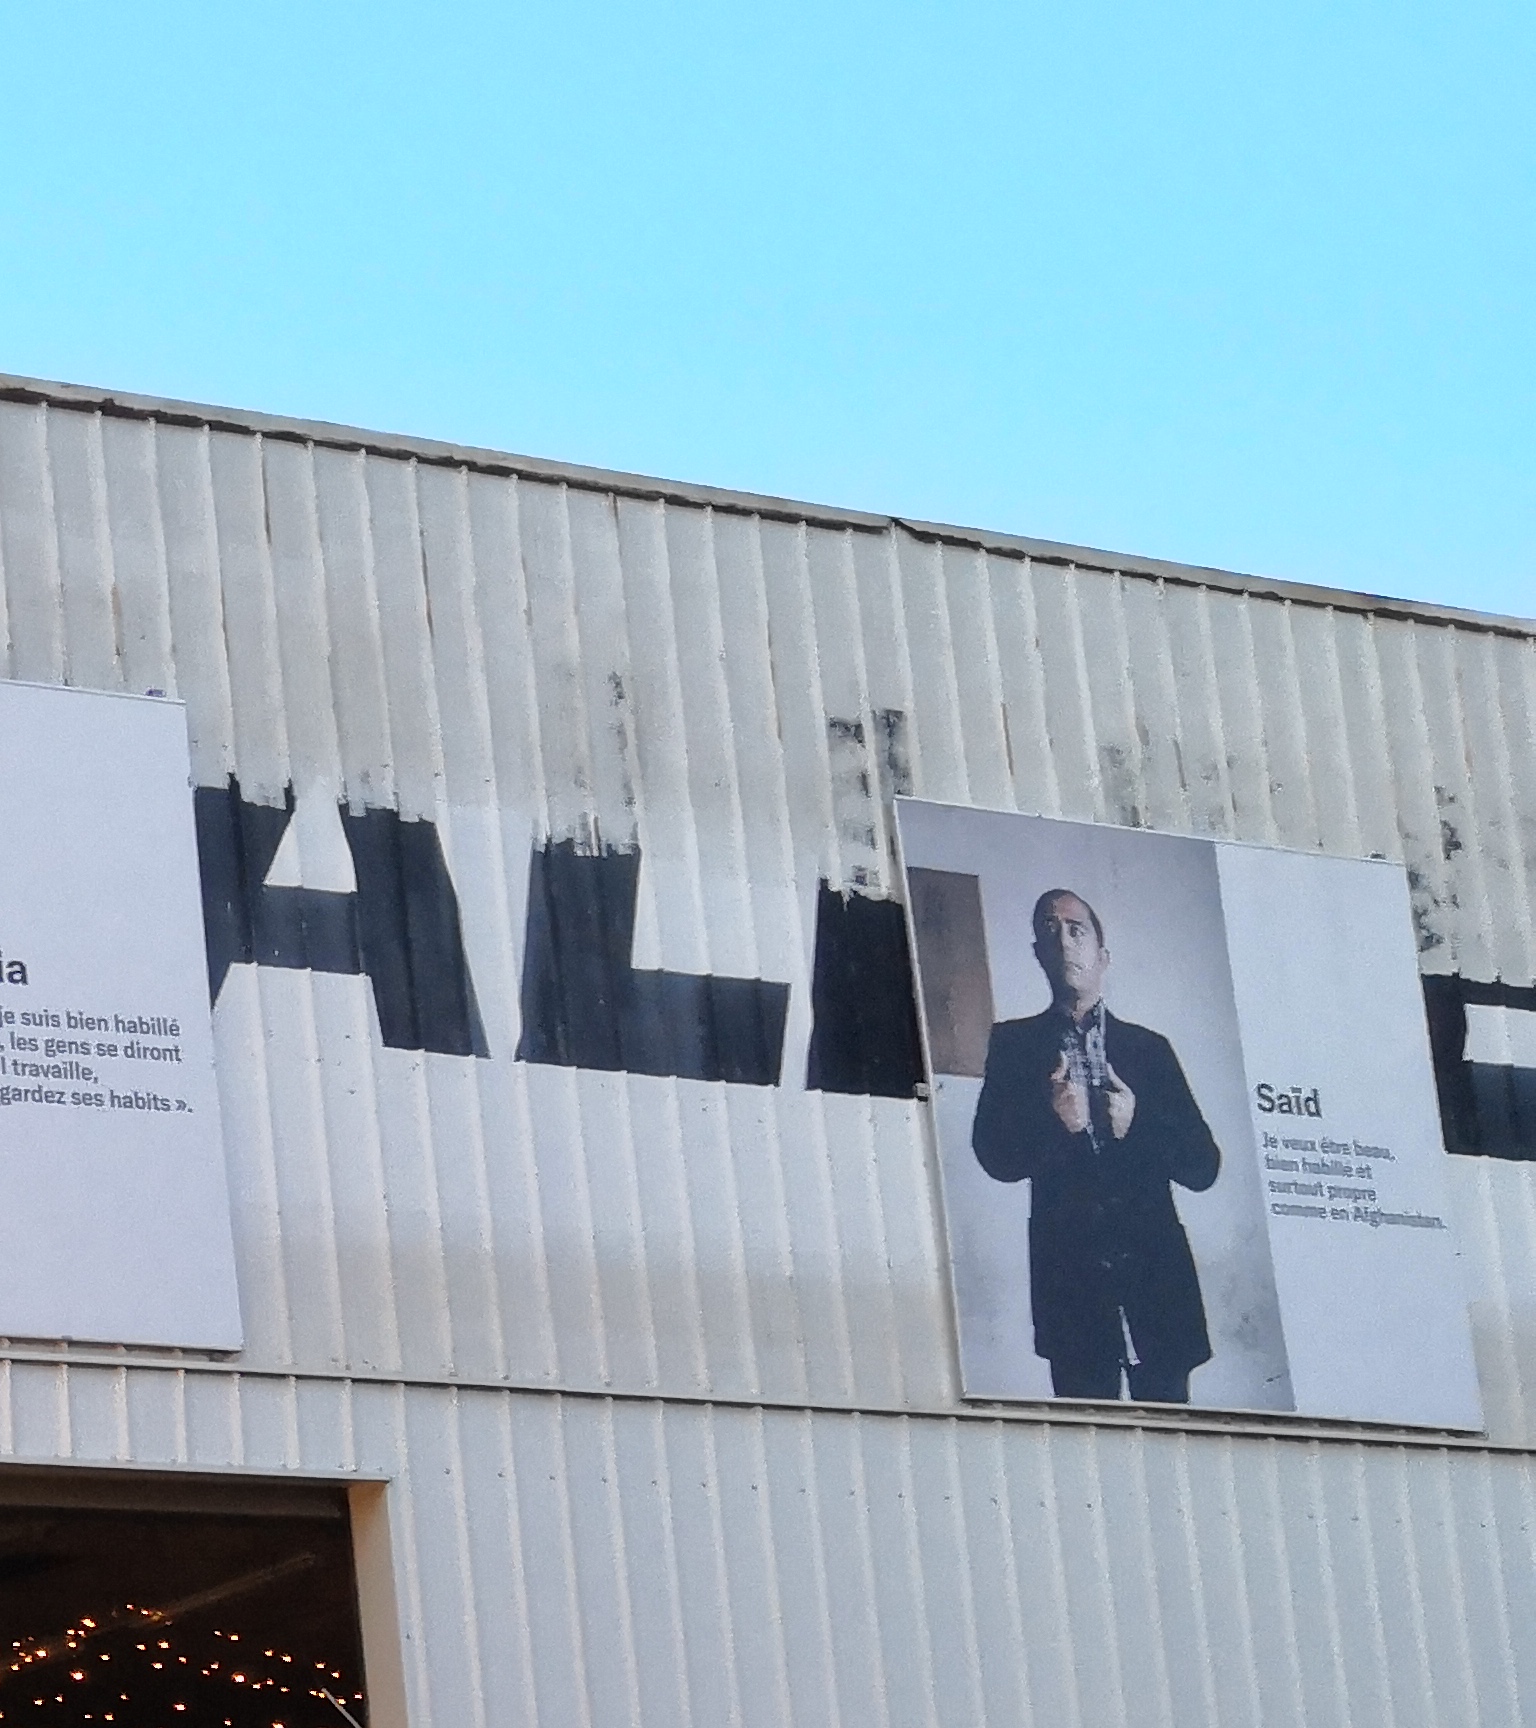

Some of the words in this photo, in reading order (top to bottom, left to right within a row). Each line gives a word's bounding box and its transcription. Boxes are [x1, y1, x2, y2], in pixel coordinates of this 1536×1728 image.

[20, 1009, 60, 1028] suis
[66, 1011, 109, 1032] bien
[114, 1014, 180, 1037] habillé
[10, 1031, 38, 1051] les
[44, 1038, 90, 1057] gens
[96, 1042, 118, 1057] se
[123, 1041, 182, 1063] diront
[12, 1058, 98, 1083] travaille,
[71, 1091, 104, 1107] ses
[110, 1090, 171, 1112] habits
[1257, 1083, 1321, 1118] Saïd
